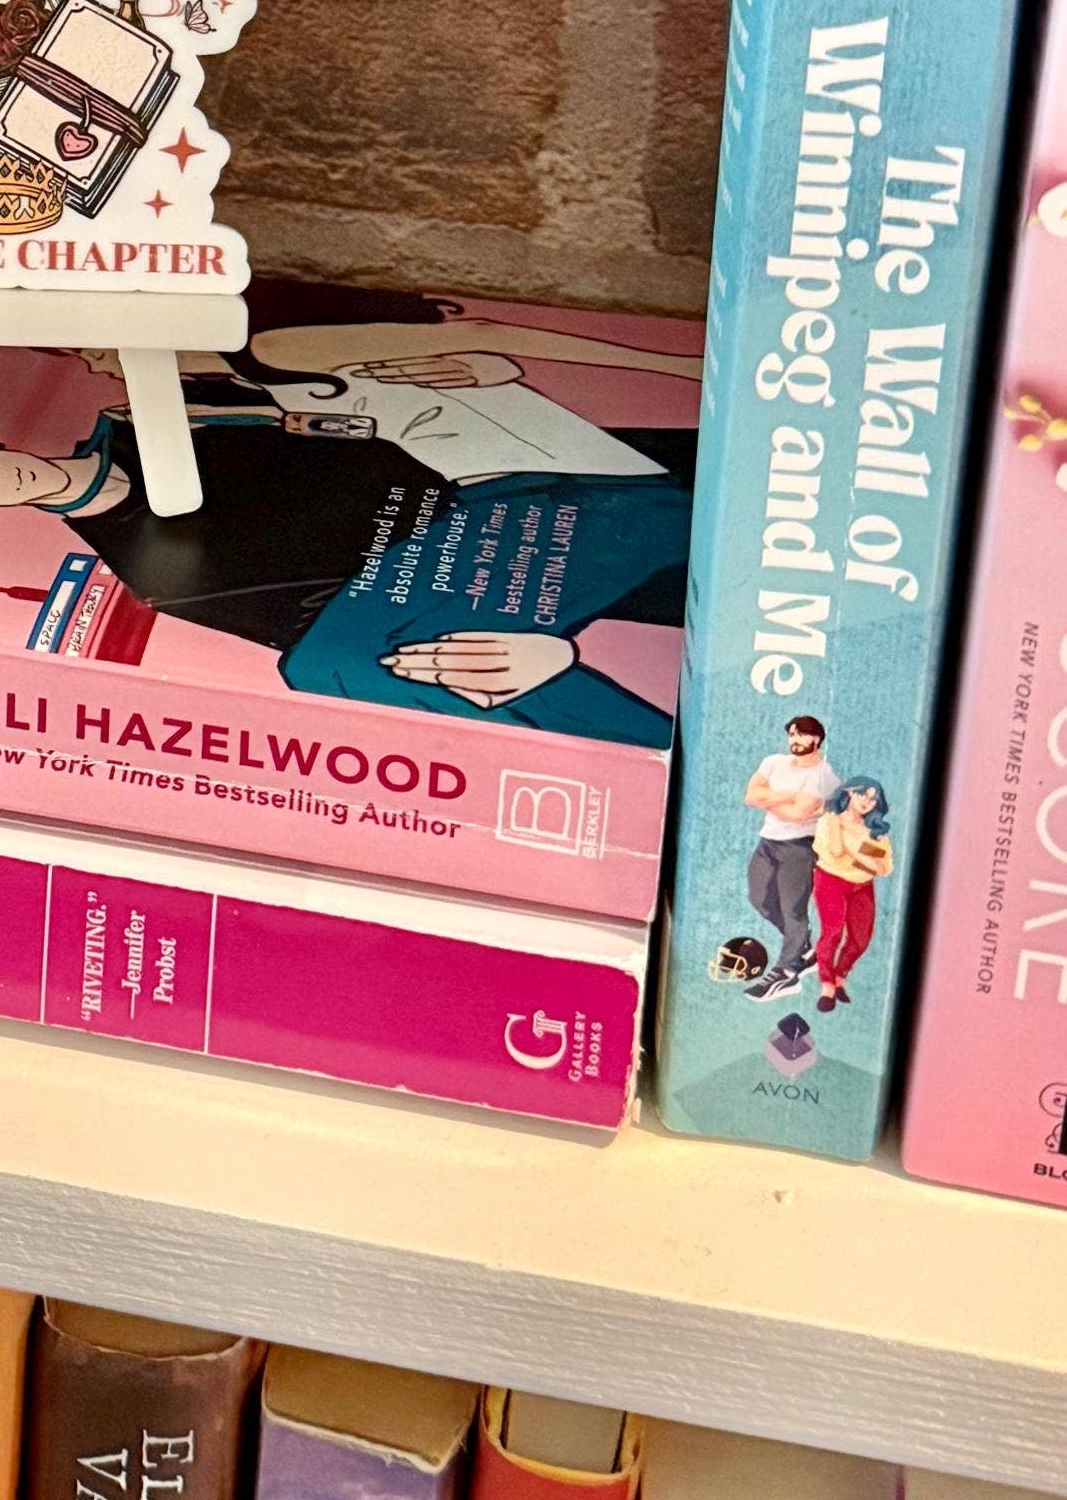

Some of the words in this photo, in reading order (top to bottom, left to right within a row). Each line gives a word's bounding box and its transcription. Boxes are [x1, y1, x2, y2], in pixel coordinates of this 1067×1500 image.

[754, 15, 889, 408] Winnipeg
[874, 145, 967, 296] The
[16, 239, 226, 278] CHAPTER
[852, 322, 947, 499] Wall
[377, 502, 401, 517] is
[388, 485, 407, 502] an
[481, 502, 509, 536] Times
[549, 503, 580, 553] LAUREN
[760, 425, 835, 574] and
[348, 515, 394, 598] "Hazelwood
[385, 543, 423, 605] absolute
[411, 487, 441, 541] romance
[473, 537, 501, 565] York
[496, 545, 541, 616] bestselling
[519, 504, 544, 543] author
[843, 513, 920, 603] of
[533, 555, 569, 627] CHRISTINA
[750, 588, 832, 698] Me
[1019, 621, 1040, 667] NEW
[1012, 672, 1033, 725] YORK
[74, 703, 469, 802] HAZELWOOD
[1003, 728, 1026, 787] TIMES
[35, 746, 95, 779] York
[104, 758, 185, 793] Times
[194, 774, 349, 826] Bestselling
[358, 800, 462, 839] Author
[582, 784, 603, 860] BERKLEY
[987, 790, 1018, 913] BESTSELLING
[153, 937, 177, 1005] Probst
[975, 918, 1001, 995] AUTHOR
[567, 1010, 587, 1083] GALLERY
[585, 1021, 604, 1079] BOOKS
[752, 1080, 821, 1105] AVON
